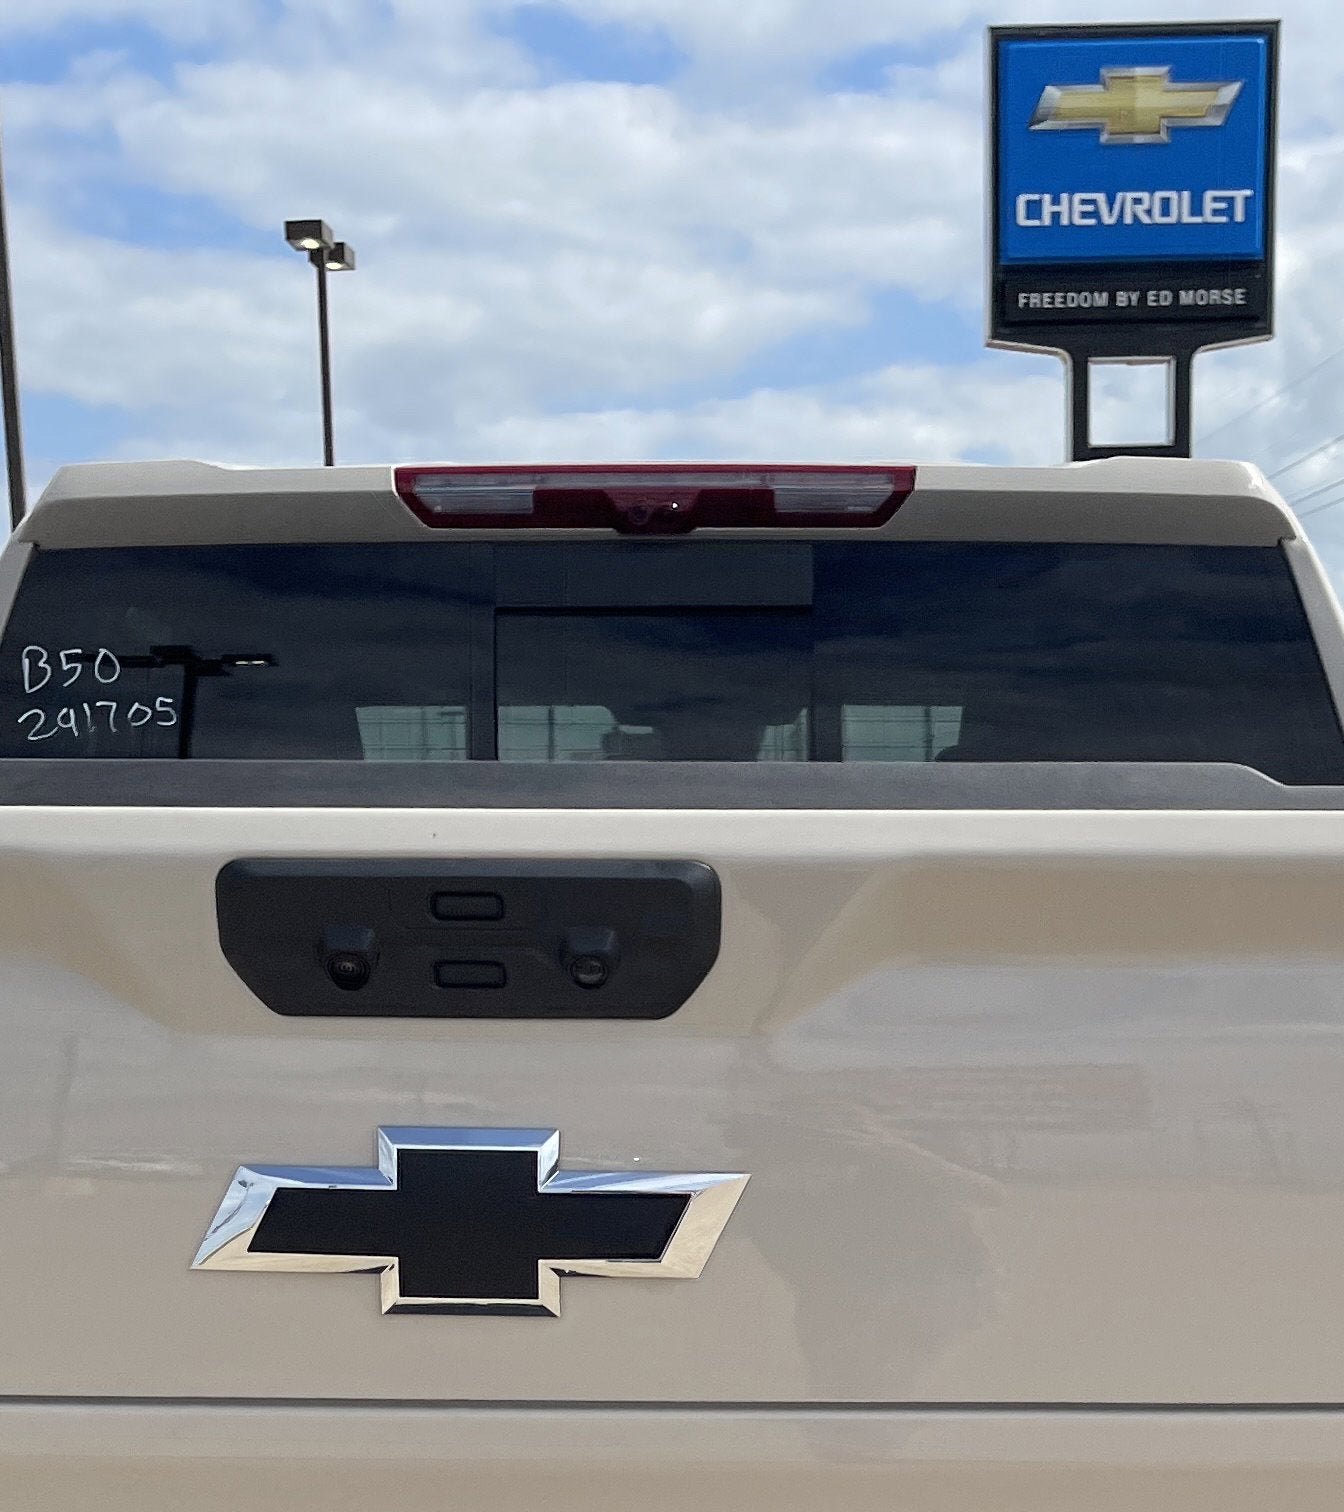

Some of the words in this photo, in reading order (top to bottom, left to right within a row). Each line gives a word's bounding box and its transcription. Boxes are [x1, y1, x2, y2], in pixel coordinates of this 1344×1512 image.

[1015, 189, 1254, 227] CHEVROLET
[1018, 291, 1108, 309] FREEDOM
[1116, 290, 1140, 307] BY
[1147, 289, 1173, 307] ED
[1179, 287, 1247, 306] MORSE
[22, 645, 121, 693] B50
